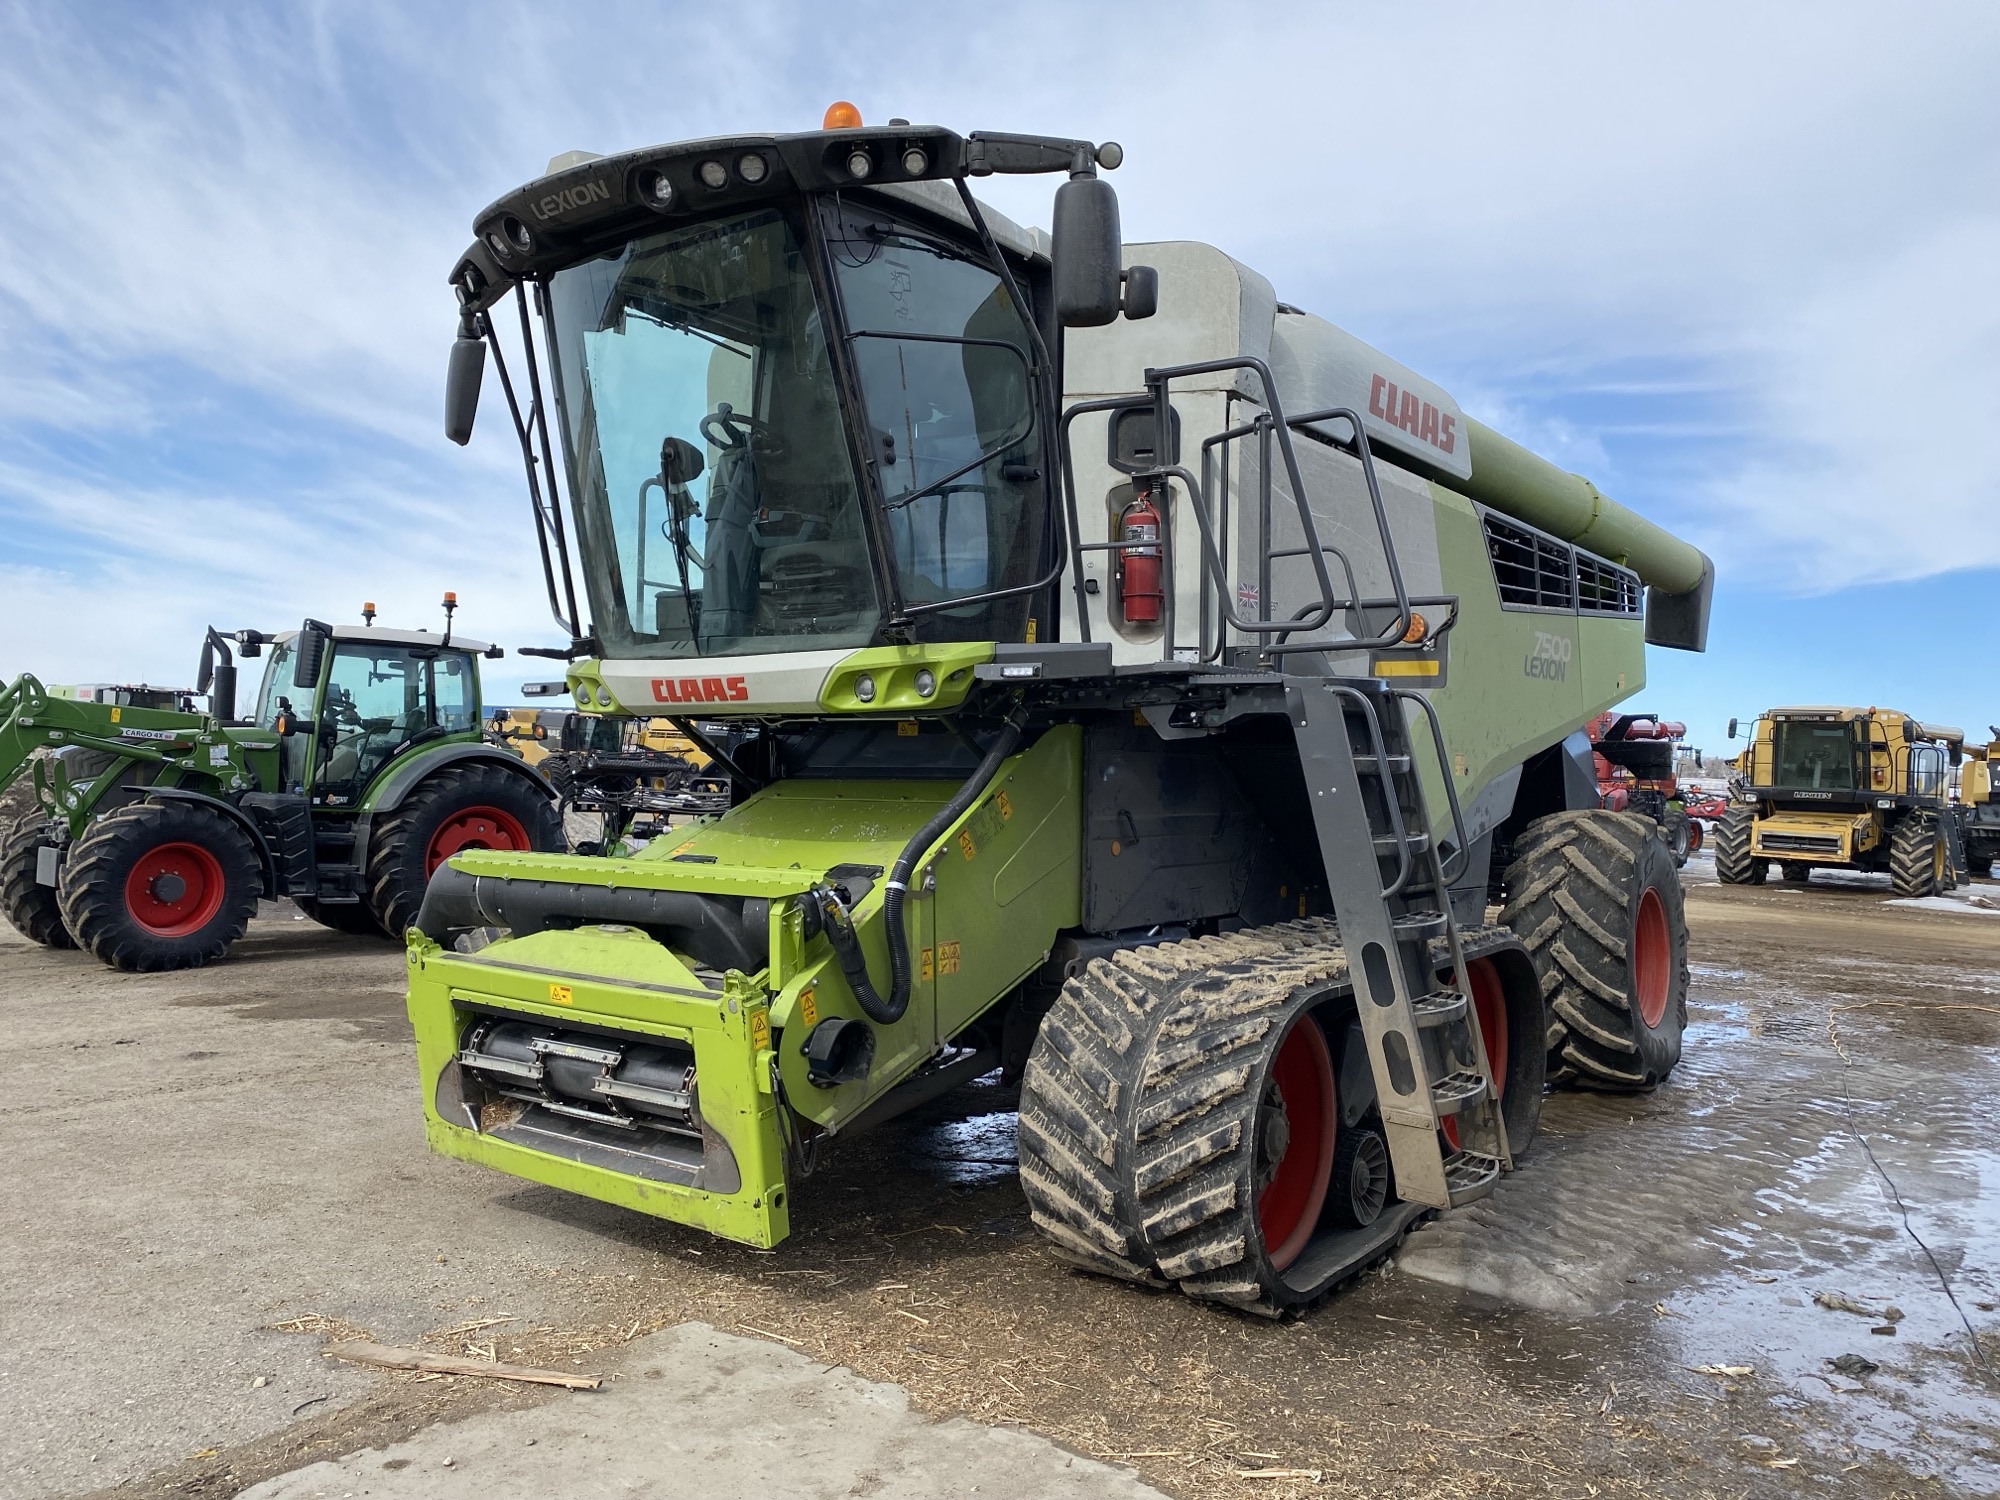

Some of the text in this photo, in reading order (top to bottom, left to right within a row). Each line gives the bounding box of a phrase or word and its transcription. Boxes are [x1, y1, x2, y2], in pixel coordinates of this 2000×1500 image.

[530, 180, 611, 220] LEXION
[1368, 373, 1456, 455] CLAAS
[1533, 630, 1571, 662] 7500
[1524, 654, 1566, 682] LEXION
[651, 676, 748, 702] CLAAS
[125, 729, 153, 738] CARGO
